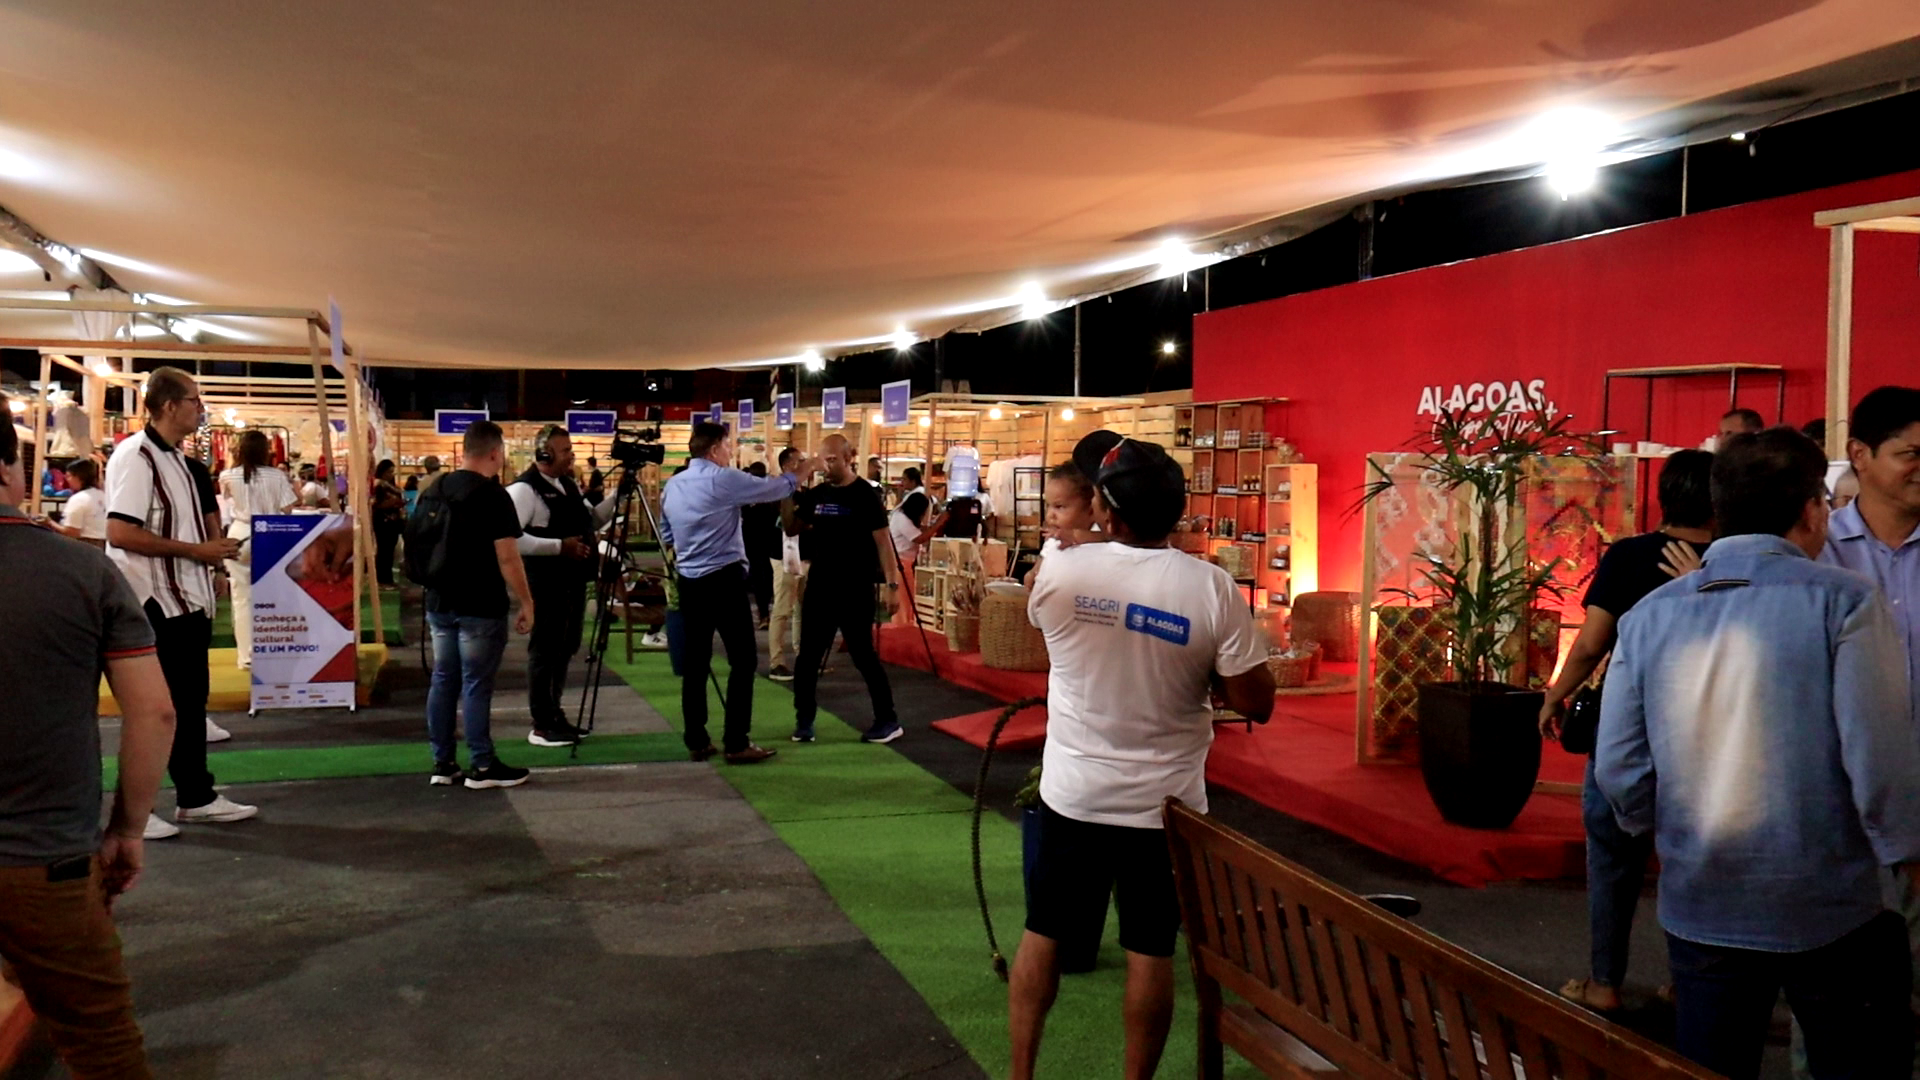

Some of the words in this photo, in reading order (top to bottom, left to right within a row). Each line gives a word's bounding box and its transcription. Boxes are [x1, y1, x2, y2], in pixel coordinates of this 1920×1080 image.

[1417, 379, 1545, 415] ALAGOAS
[1075, 595, 1119, 612] SEAGRI
[253, 615, 297, 624] Conheça
[253, 625, 309, 633] identidade
[1147, 616, 1184, 634] ALAGOAS
[253, 635, 294, 643] cultural
[269, 645, 286, 653] UM
[288, 645, 319, 653] POVO!
